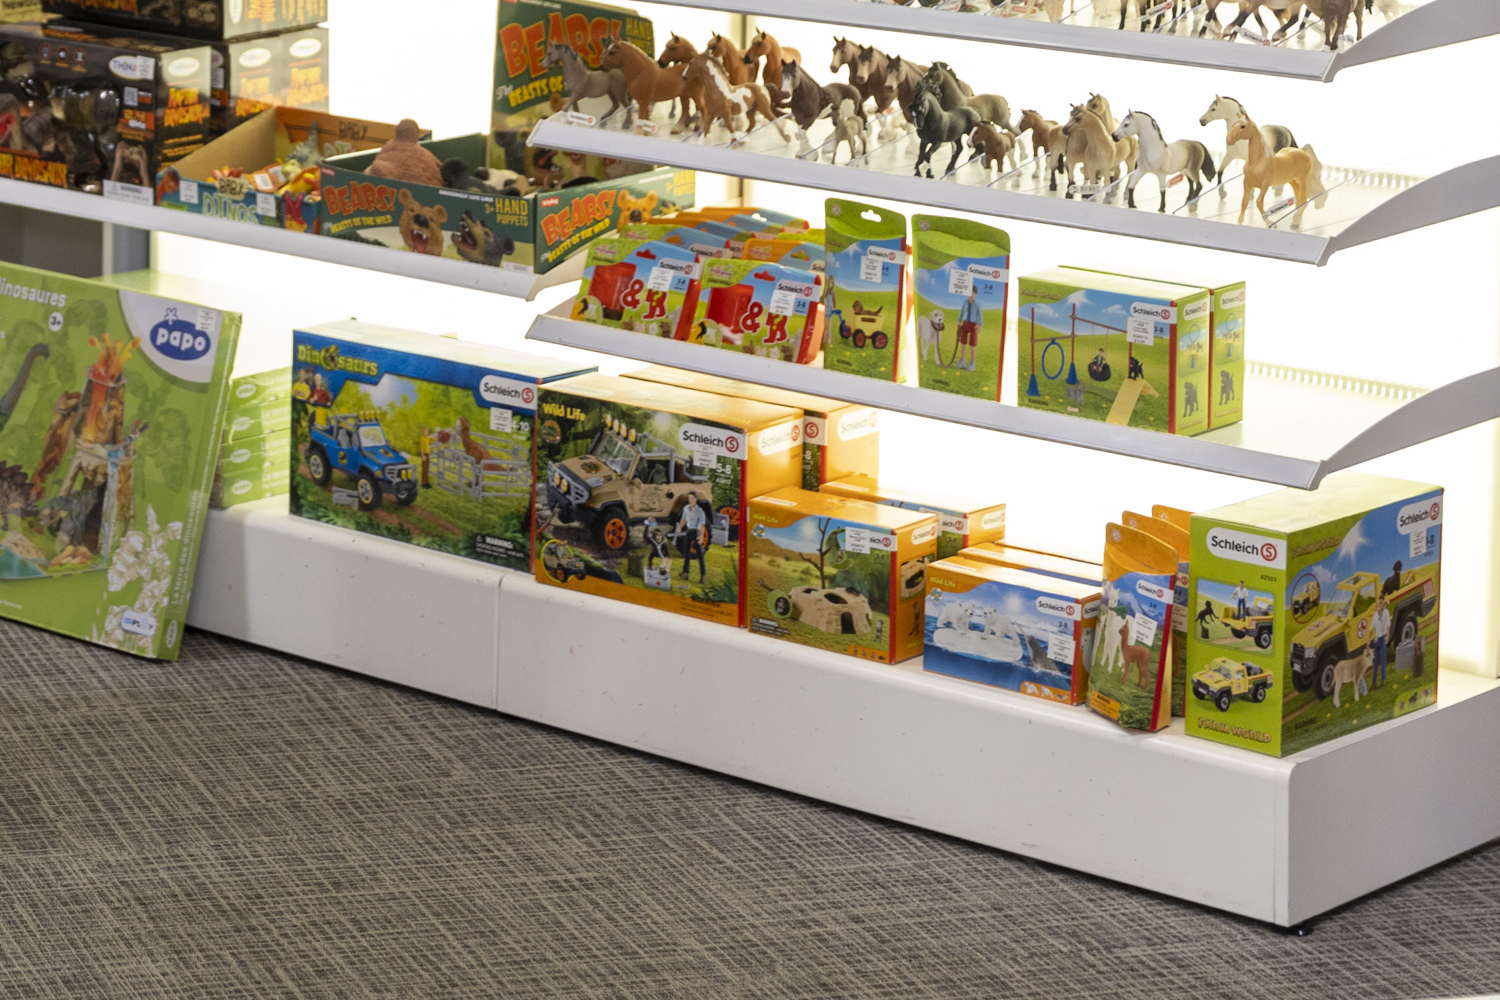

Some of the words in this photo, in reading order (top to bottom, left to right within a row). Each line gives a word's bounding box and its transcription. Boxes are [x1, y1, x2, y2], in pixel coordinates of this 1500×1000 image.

[508, 78, 548, 108] BEASTS
[218, 178, 244, 196] BABY
[322, 181, 397, 216] BEARS!
[495, 198, 528, 216] HAND
[496, 213, 529, 227] PUPPETS
[540, 189, 618, 247] BEARS!
[778, 281, 804, 294] Schleich
[1132, 306, 1161, 318] Schleich
[49, 316, 63, 328] 3+
[155, 326, 207, 352] papo
[484, 382, 521, 400] Schleich
[542, 402, 565, 417] Wild
[567, 407, 586, 421] Life
[682, 429, 724, 448] Schleich
[715, 463, 732, 476] 5-8
[1399, 508, 1429, 527] Schleich
[1211, 536, 1259, 556] Schleich
[1038, 600, 1066, 614] Schleich
[1197, 717, 1229, 736] FARM
[1231, 725, 1272, 744] WORLD
